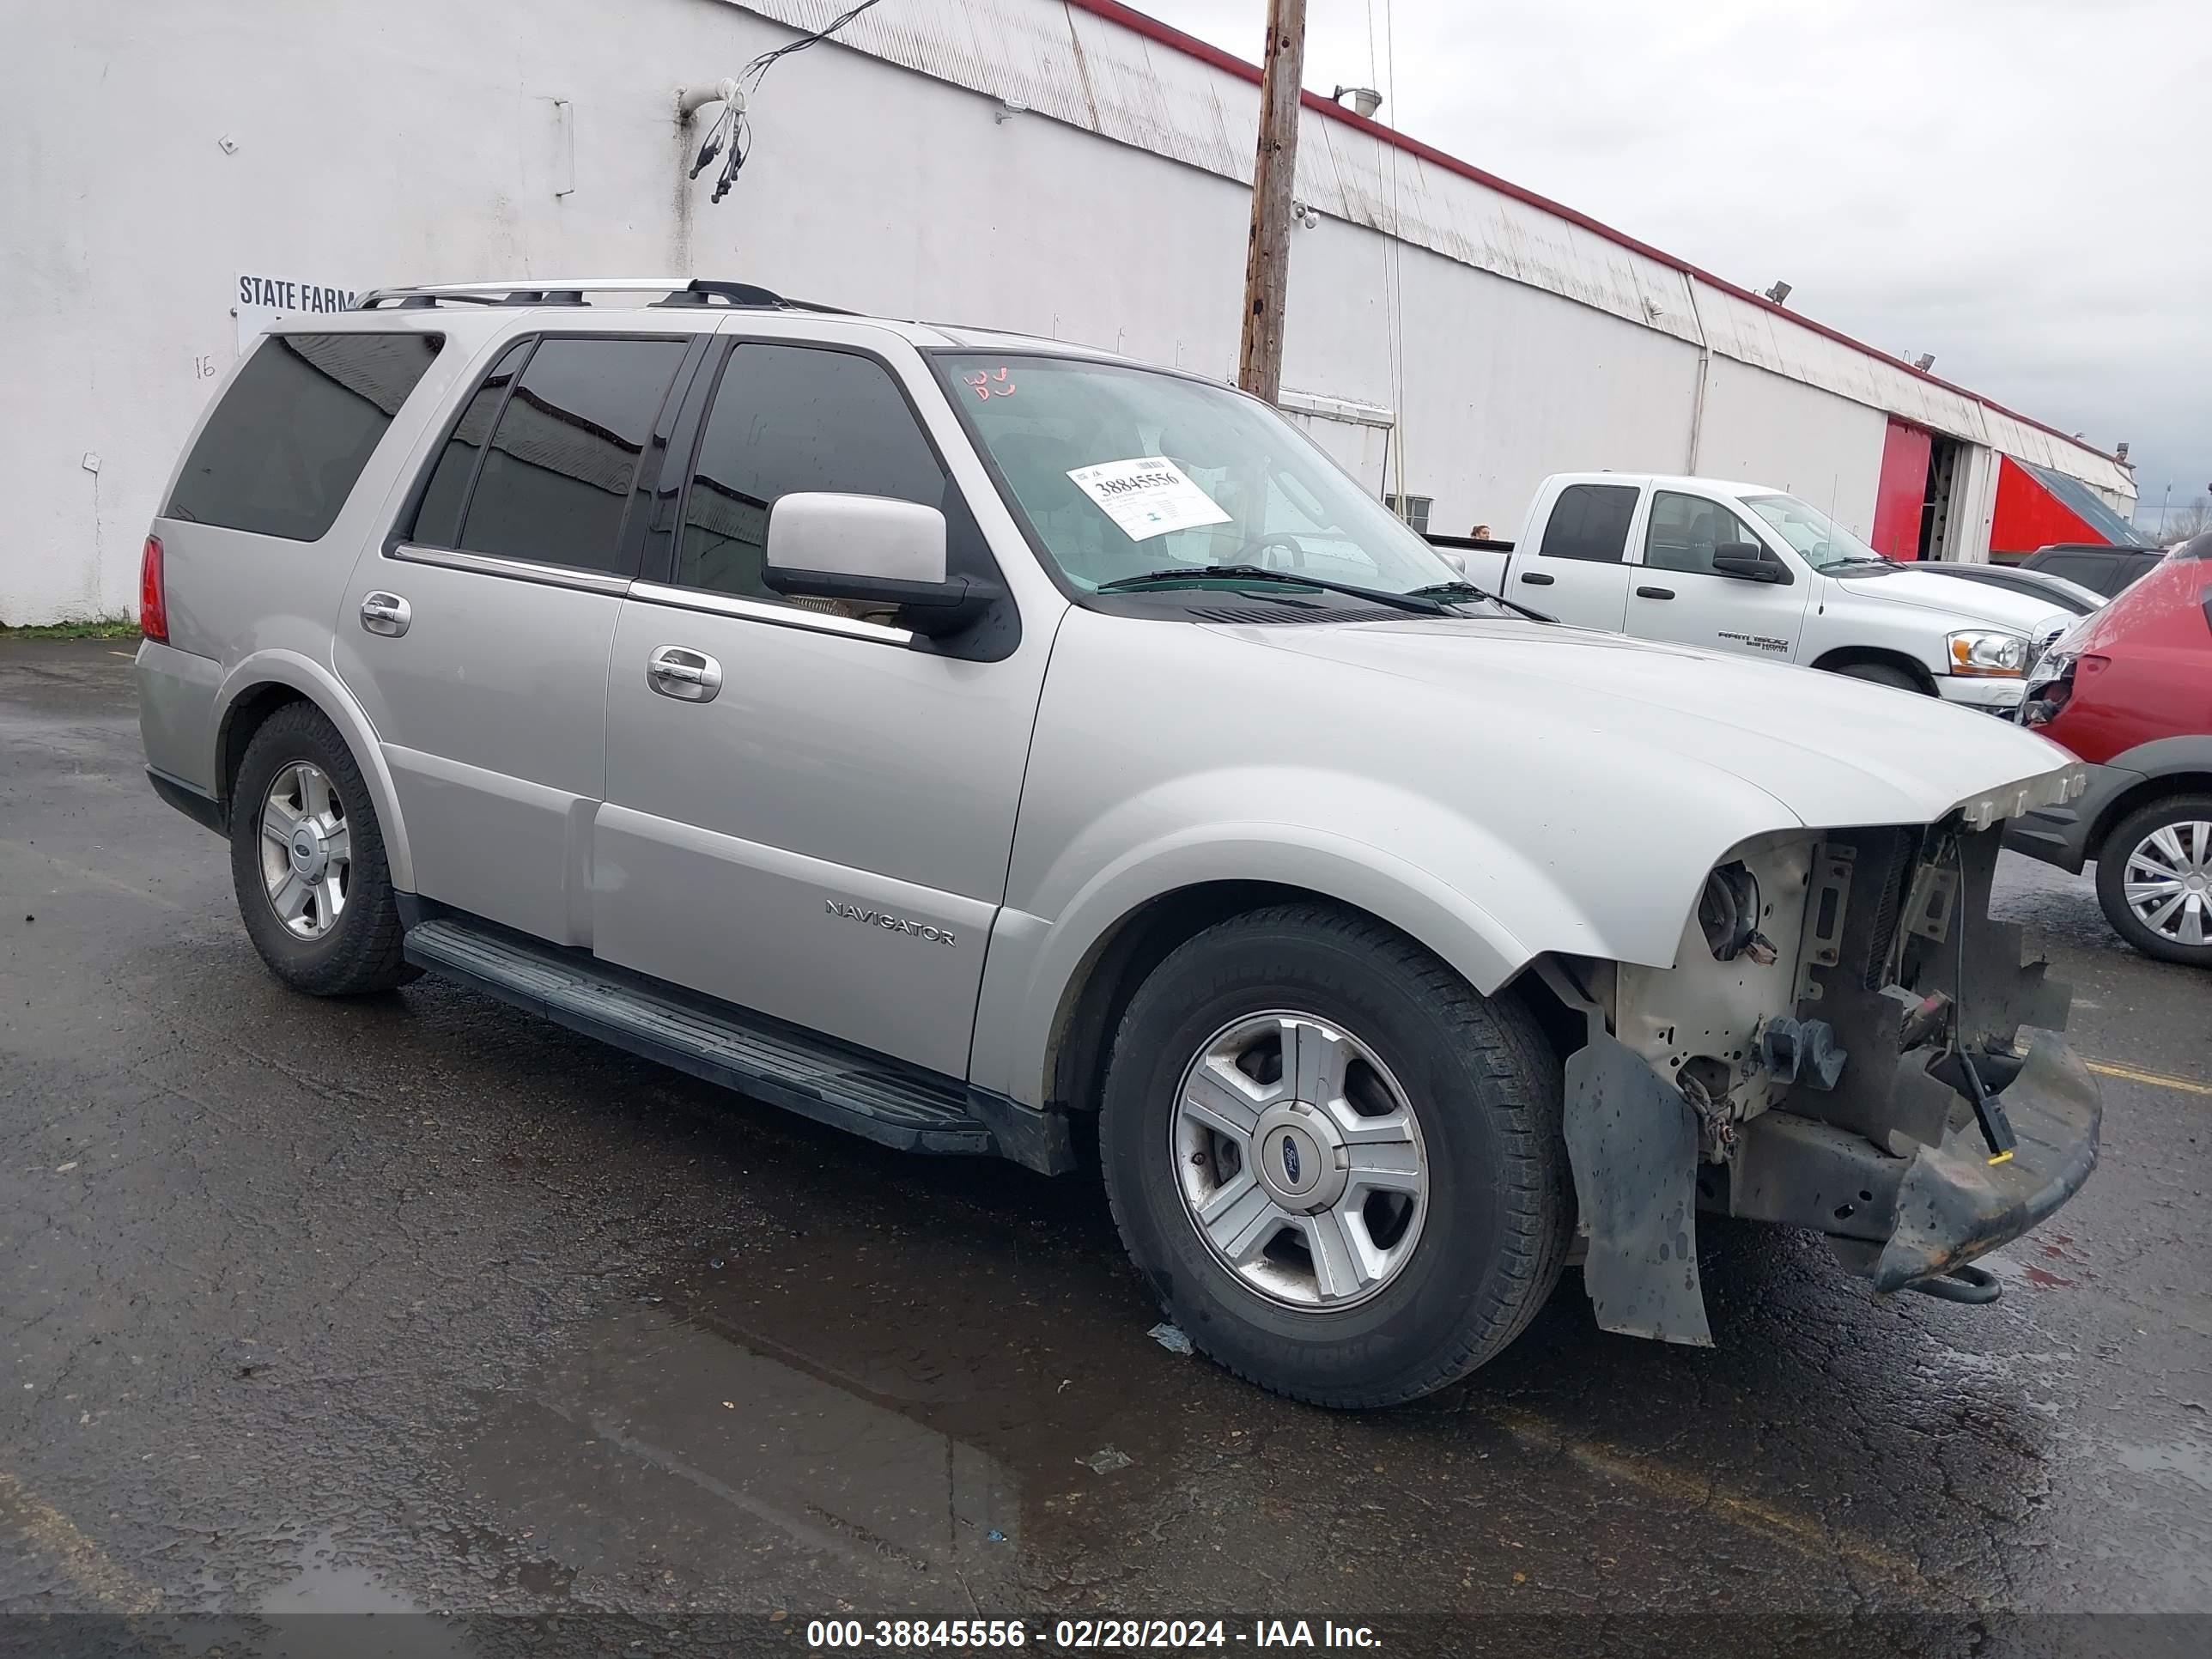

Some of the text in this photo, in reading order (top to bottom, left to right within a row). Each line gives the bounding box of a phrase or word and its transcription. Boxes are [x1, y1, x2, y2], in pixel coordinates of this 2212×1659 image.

[240, 275, 296, 310] STATE
[194, 355, 216, 379] 16
[1095, 471, 1180, 497] 38845556
[1717, 630, 1790, 646] RAM 1500
[825, 898, 957, 947] NAVIGATOR
